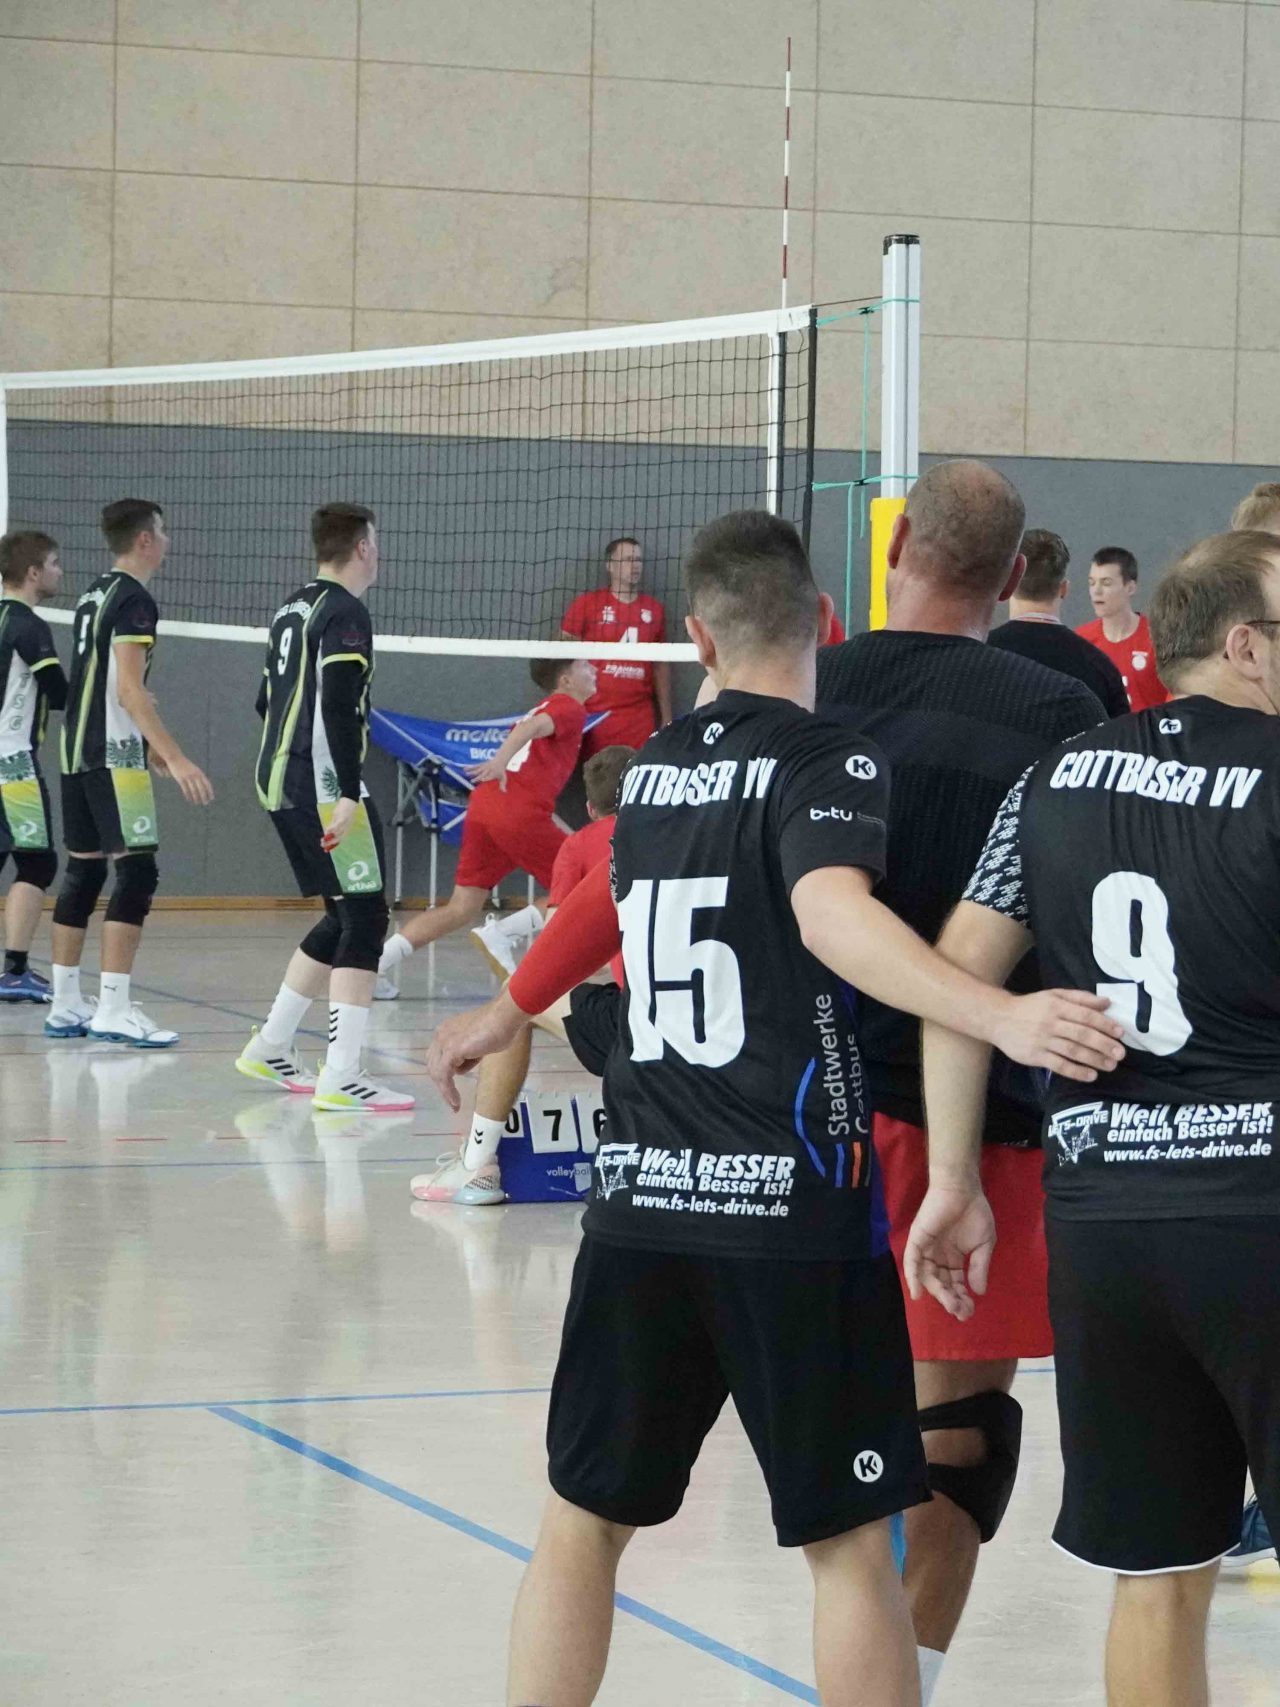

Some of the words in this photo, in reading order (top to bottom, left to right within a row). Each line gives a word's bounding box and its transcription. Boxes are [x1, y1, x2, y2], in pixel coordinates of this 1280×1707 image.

[277, 626, 293, 676] 9
[445, 728, 511, 743] molte
[620, 760, 739, 807] OTTBUSER
[1049, 749, 1207, 807] COTTBUSER
[1208, 766, 1263, 808] VV
[617, 875, 746, 1069] 15
[1091, 870, 1194, 1057] 9
[813, 993, 850, 1136] Stadtwerke
[542, 1109, 563, 1142] 7
[1107, 1122, 1173, 1143] einfach
[1177, 1119, 1238, 1140] Besser
[1241, 1114, 1274, 1135] ist!
[1110, 1102, 1169, 1129] Weil
[1174, 1102, 1273, 1124] BESSER
[640, 1147, 693, 1177] Weil
[695, 1152, 796, 1181] BESSER
[1103, 1138, 1273, 1162] www.fs-lets-drive.de
[636, 1168, 694, 1191] einfach
[698, 1173, 760, 1194] Besser
[763, 1175, 794, 1196] ist!
[632, 1193, 790, 1217] www.fs-lets-drive.de
